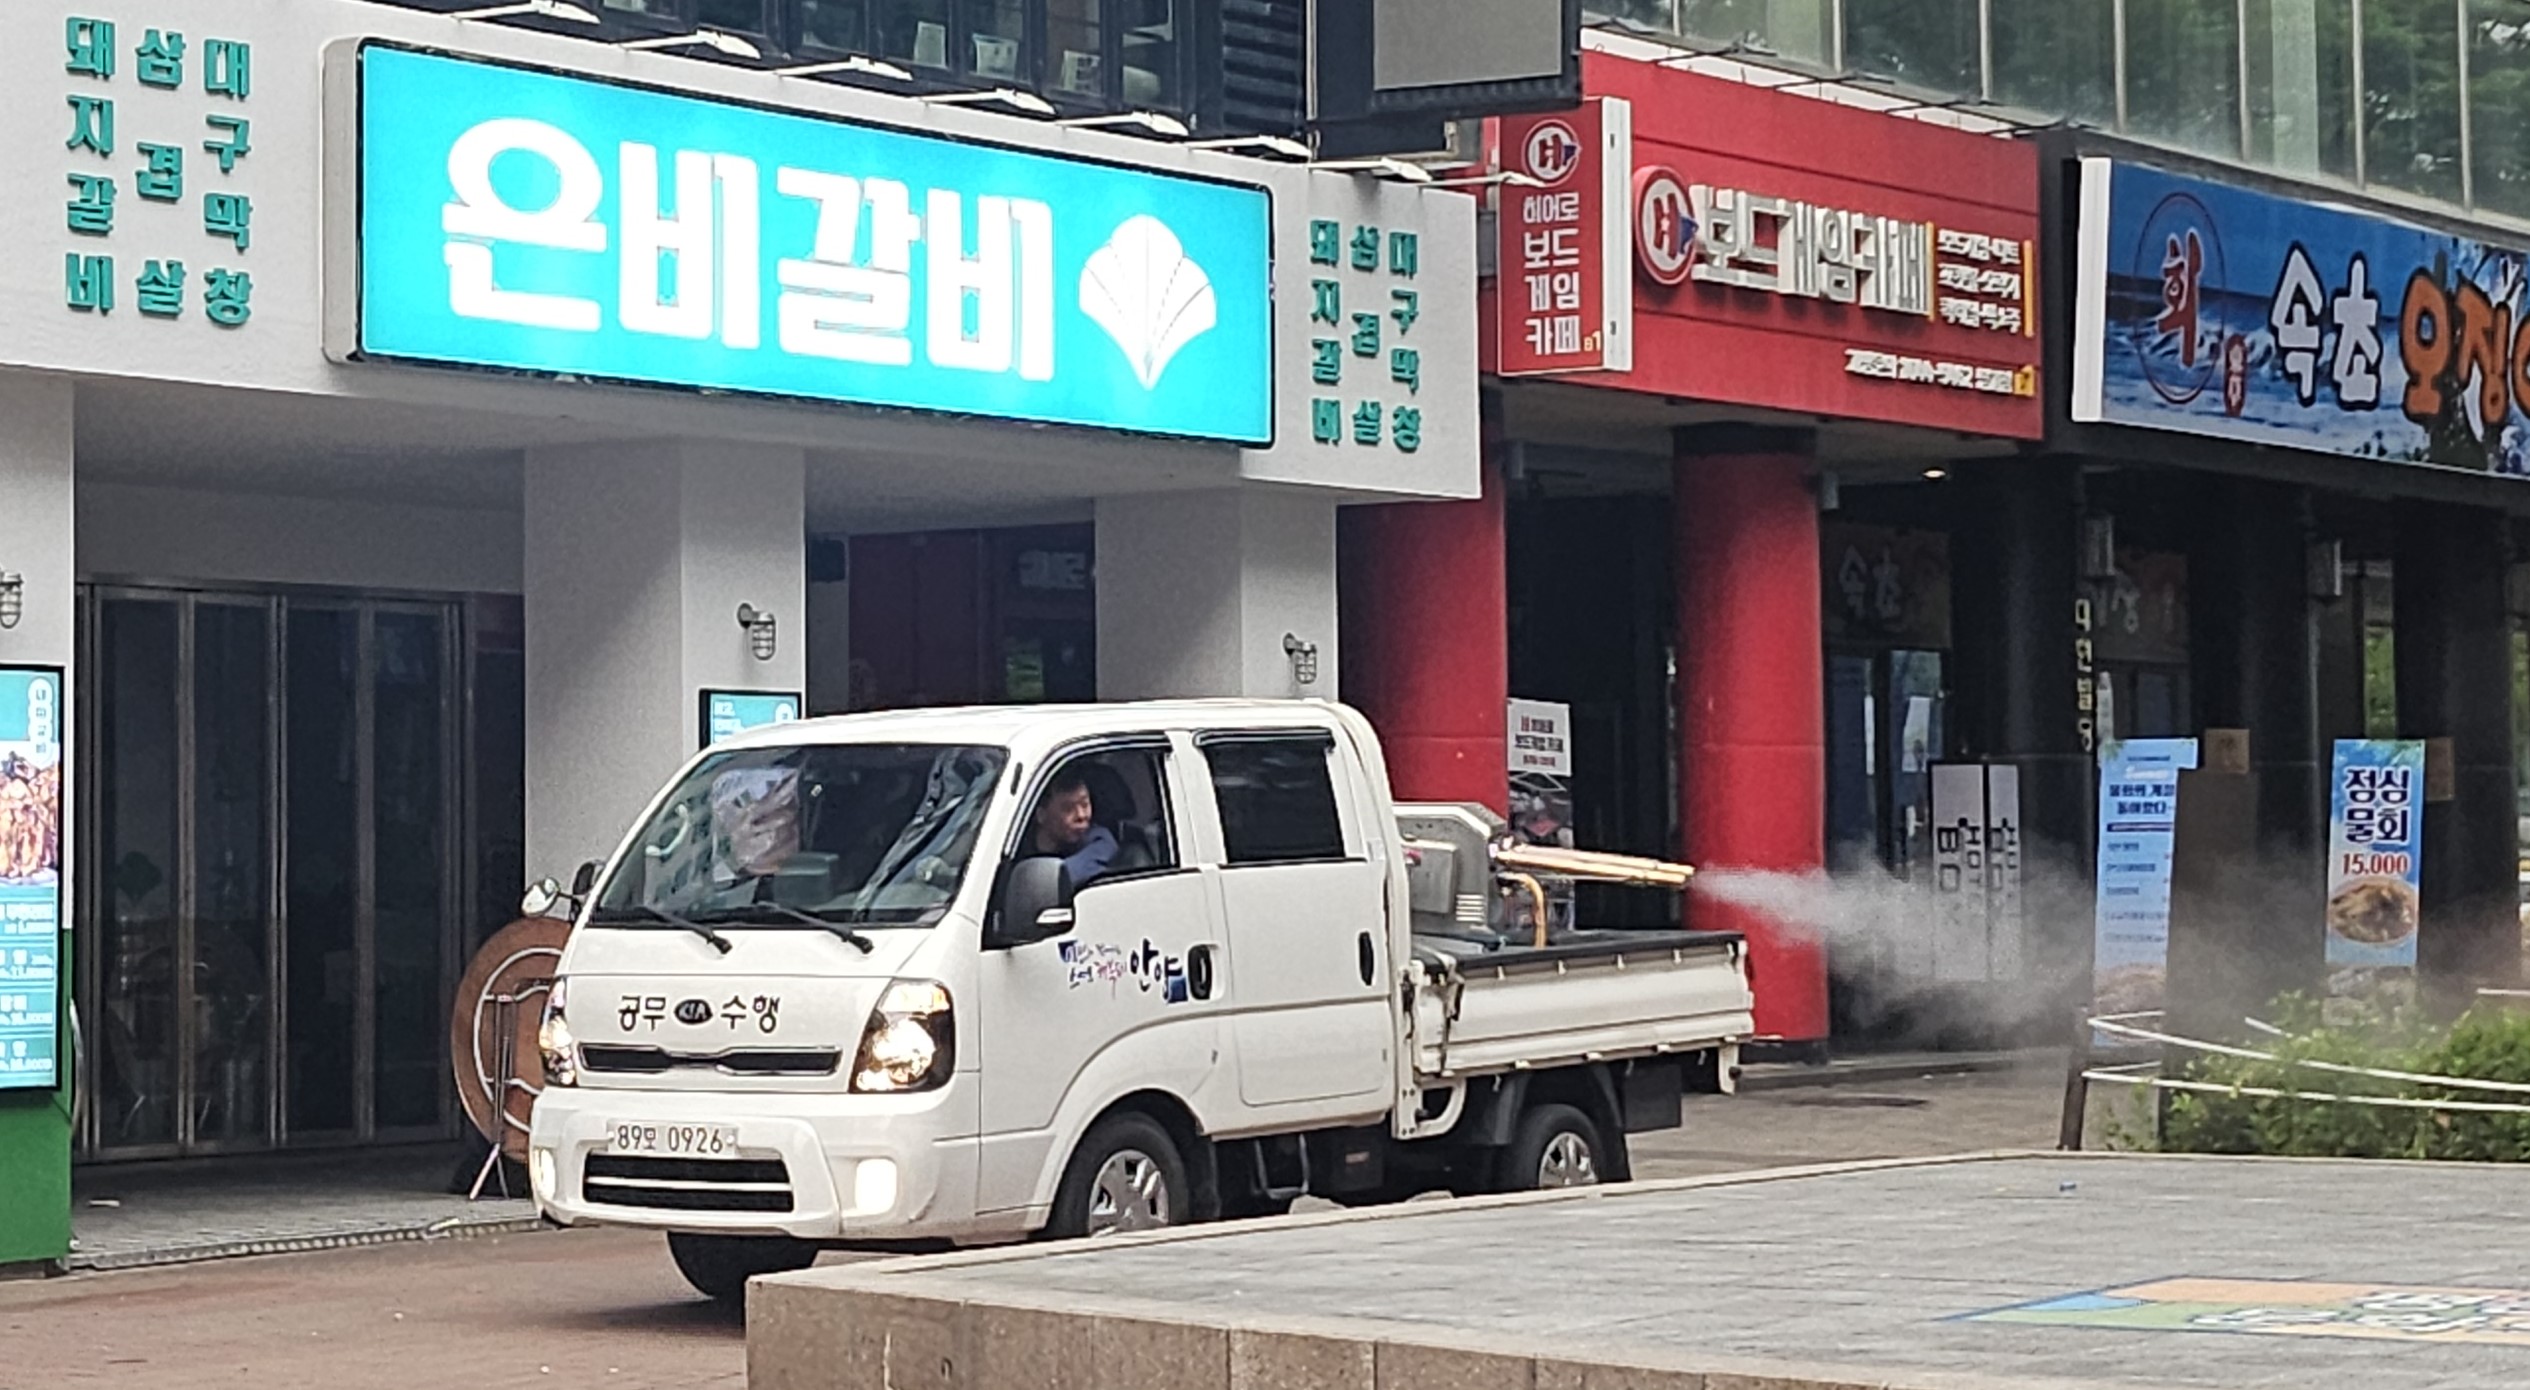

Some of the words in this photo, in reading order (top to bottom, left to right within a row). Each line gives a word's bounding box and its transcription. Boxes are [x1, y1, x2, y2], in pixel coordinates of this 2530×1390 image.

[65, 15, 117, 315] 돼지갈비
[134, 28, 186, 318] 삼겹살
[203, 38, 252, 325] 대구막창
[1522, 192, 1580, 224] 히어로
[442, 117, 1055, 381] 은비갈비
[1523, 228, 1580, 270] 보드
[1523, 271, 1580, 313] 게임
[1689, 183, 1929, 316] 보드게임카페
[1310, 219, 1343, 447] 돼지갈비
[1350, 224, 1383, 447] 삼겹살
[1389, 231, 1421, 454] 대구막창
[1524, 315, 1581, 356] 카페
[2270, 243, 2383, 409] 속초
[2344, 768, 2410, 804] 점심
[2344, 807, 2409, 843] 물회
[618, 995, 667, 1032] 공무
[719, 995, 781, 1034] 수행
[667, 1126, 723, 1154] 0926
